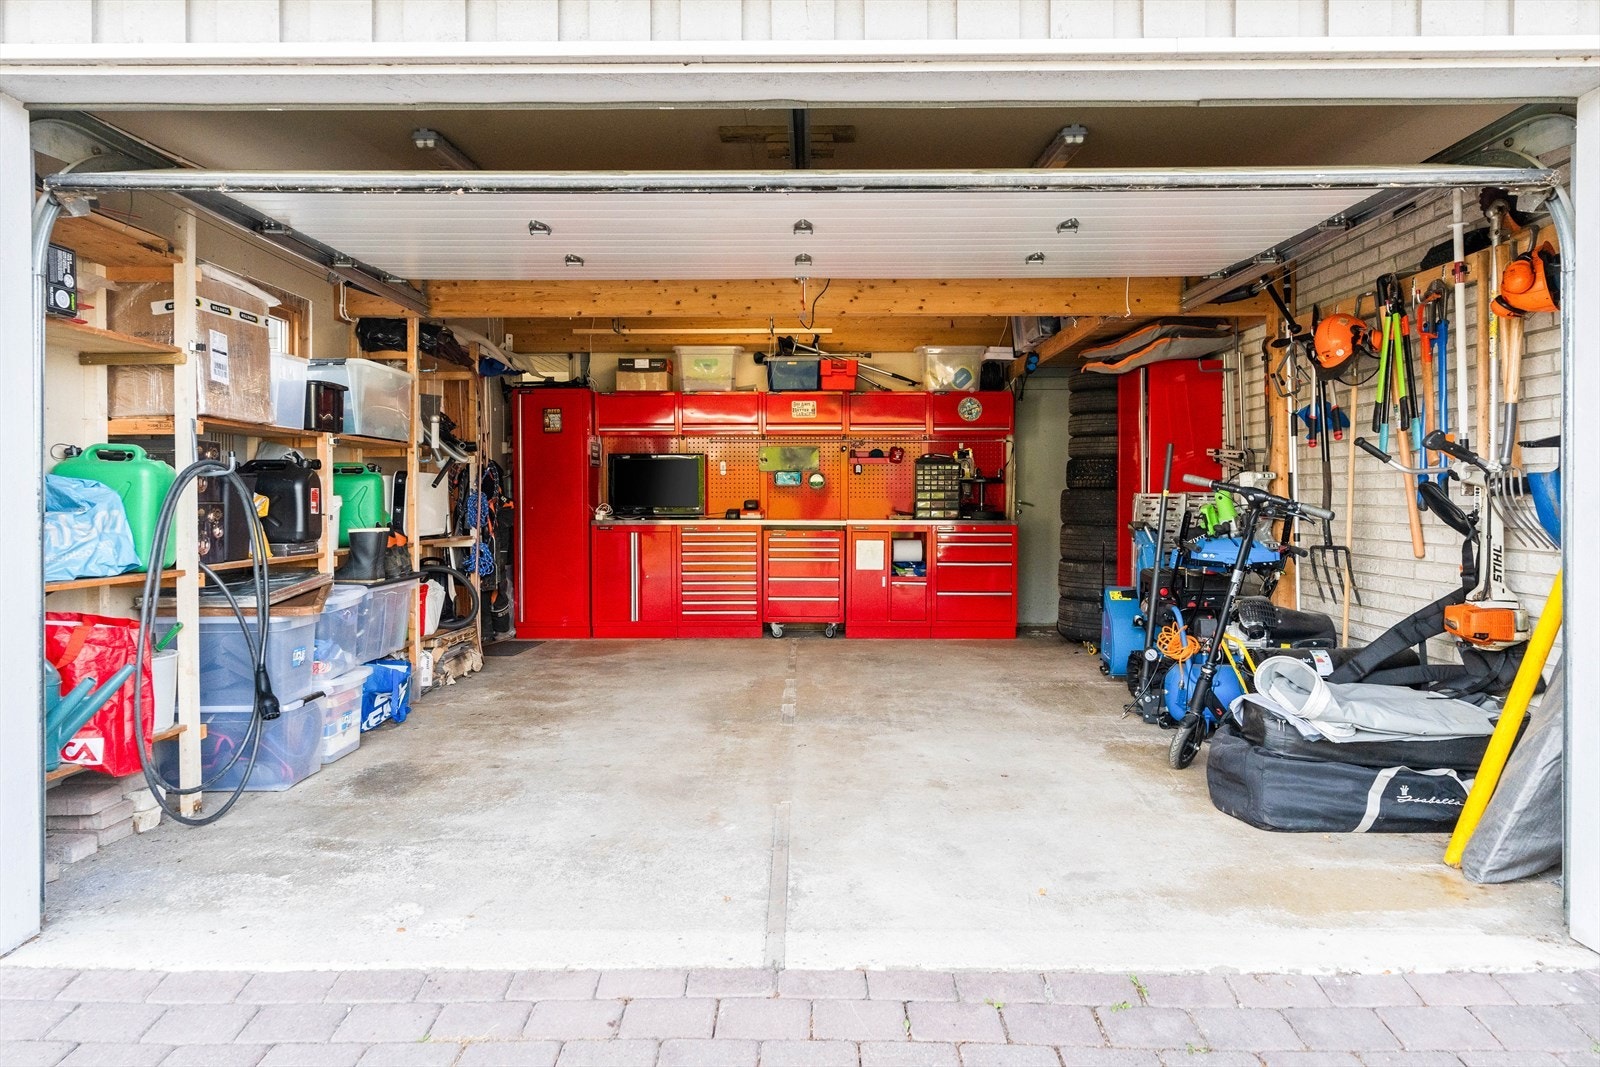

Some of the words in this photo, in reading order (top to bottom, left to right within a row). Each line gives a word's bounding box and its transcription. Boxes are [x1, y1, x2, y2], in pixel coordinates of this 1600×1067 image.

[1493, 545, 1502, 583] STIHL
[61, 741, 98, 762] CA
[1396, 795, 1465, 806] Isabella
